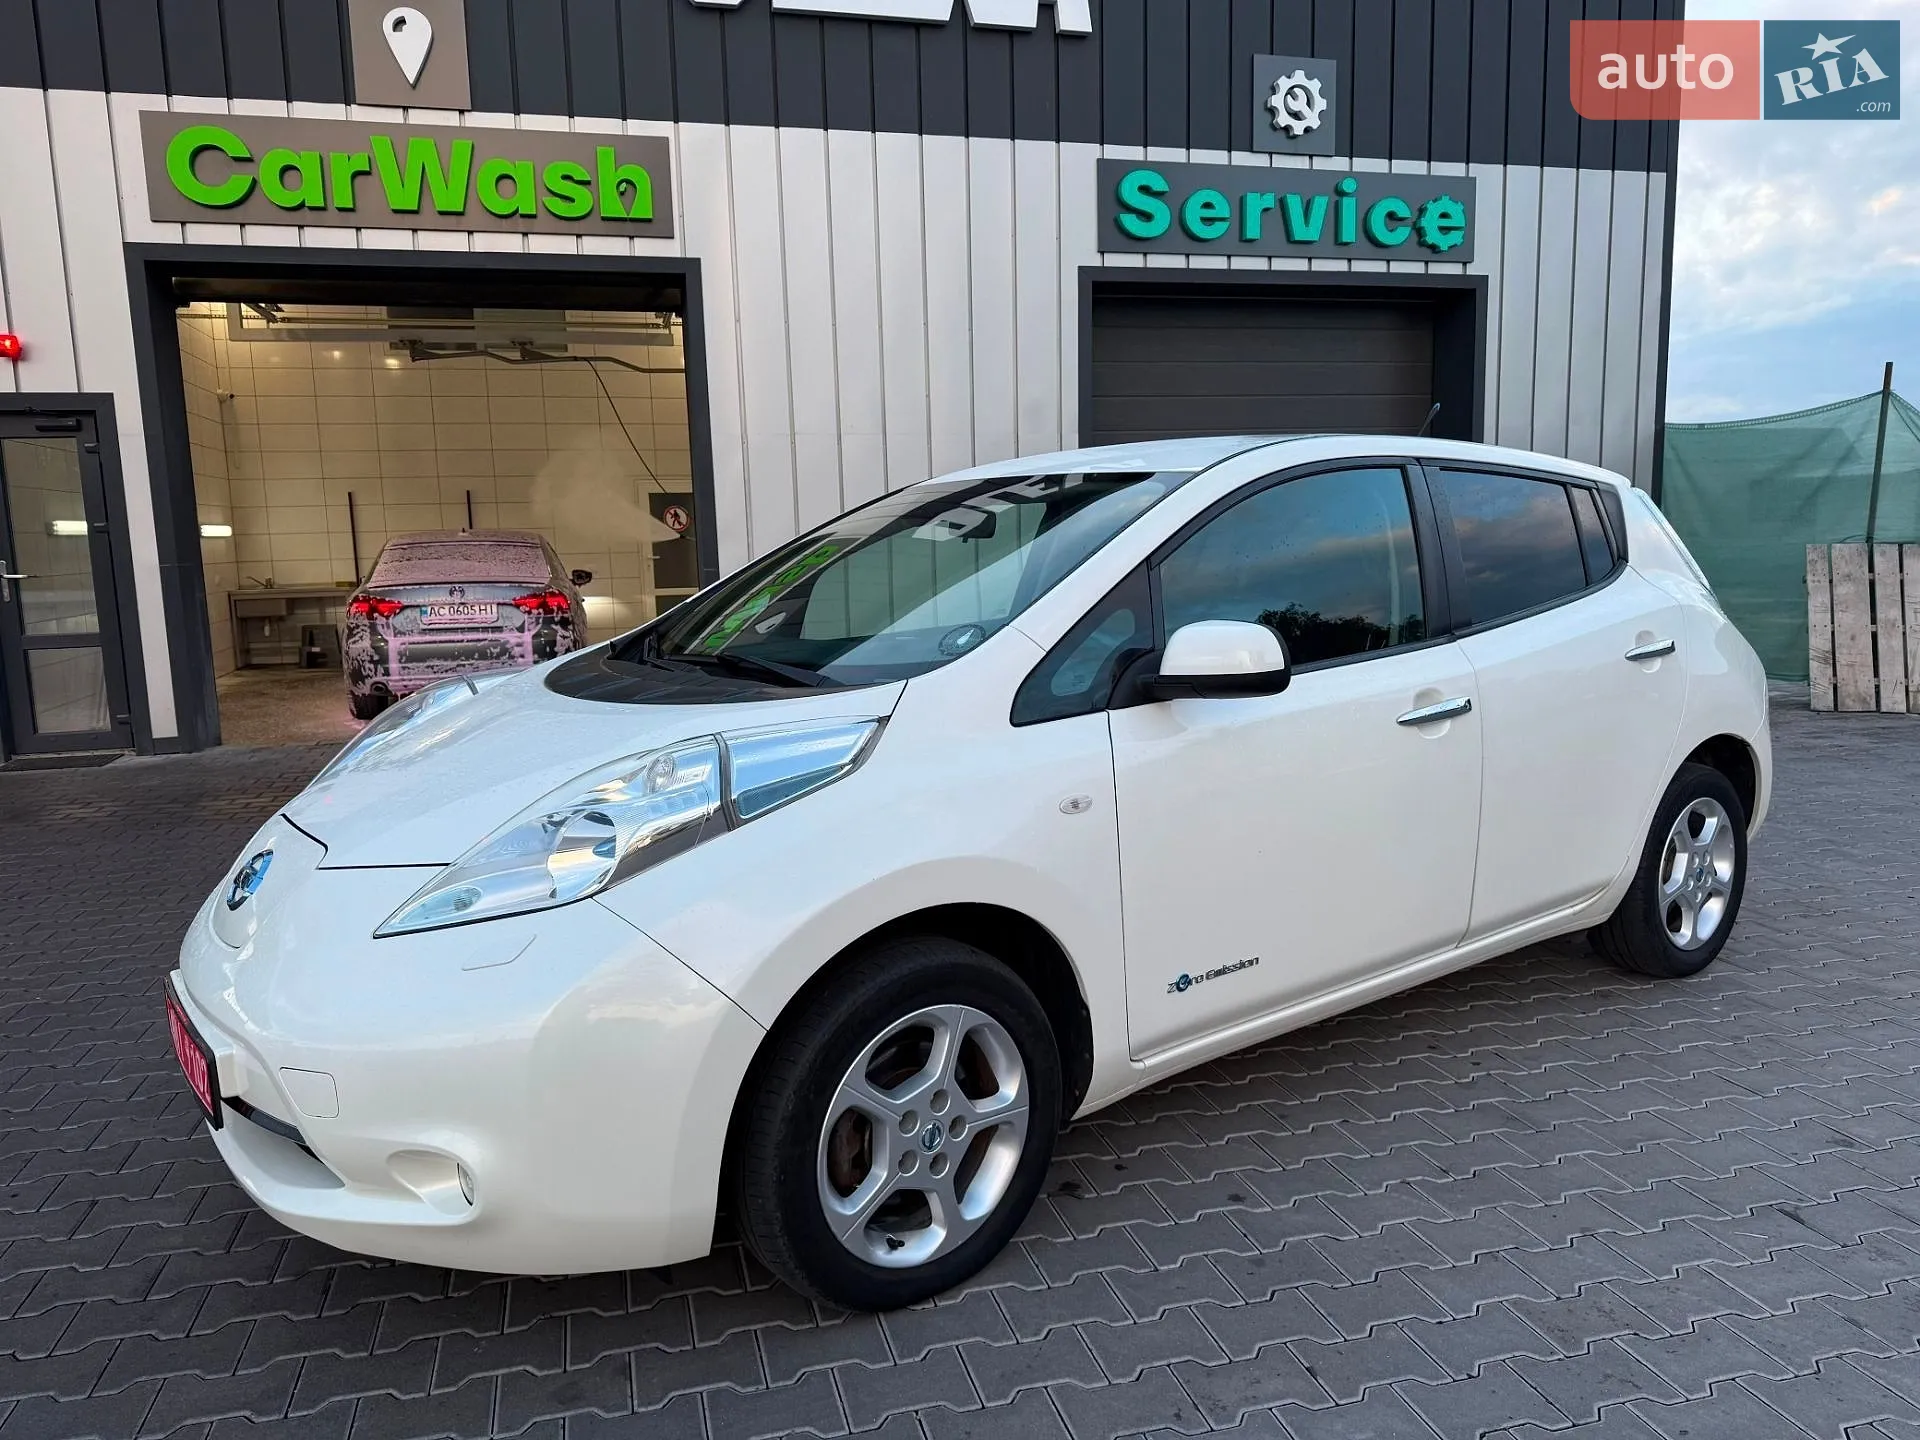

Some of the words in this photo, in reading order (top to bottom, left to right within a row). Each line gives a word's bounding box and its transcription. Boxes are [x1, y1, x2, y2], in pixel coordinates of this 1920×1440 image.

[165, 124, 655, 222] CarWash
[1114, 168, 1468, 253] Service
[448, 605, 477, 616] 0605
